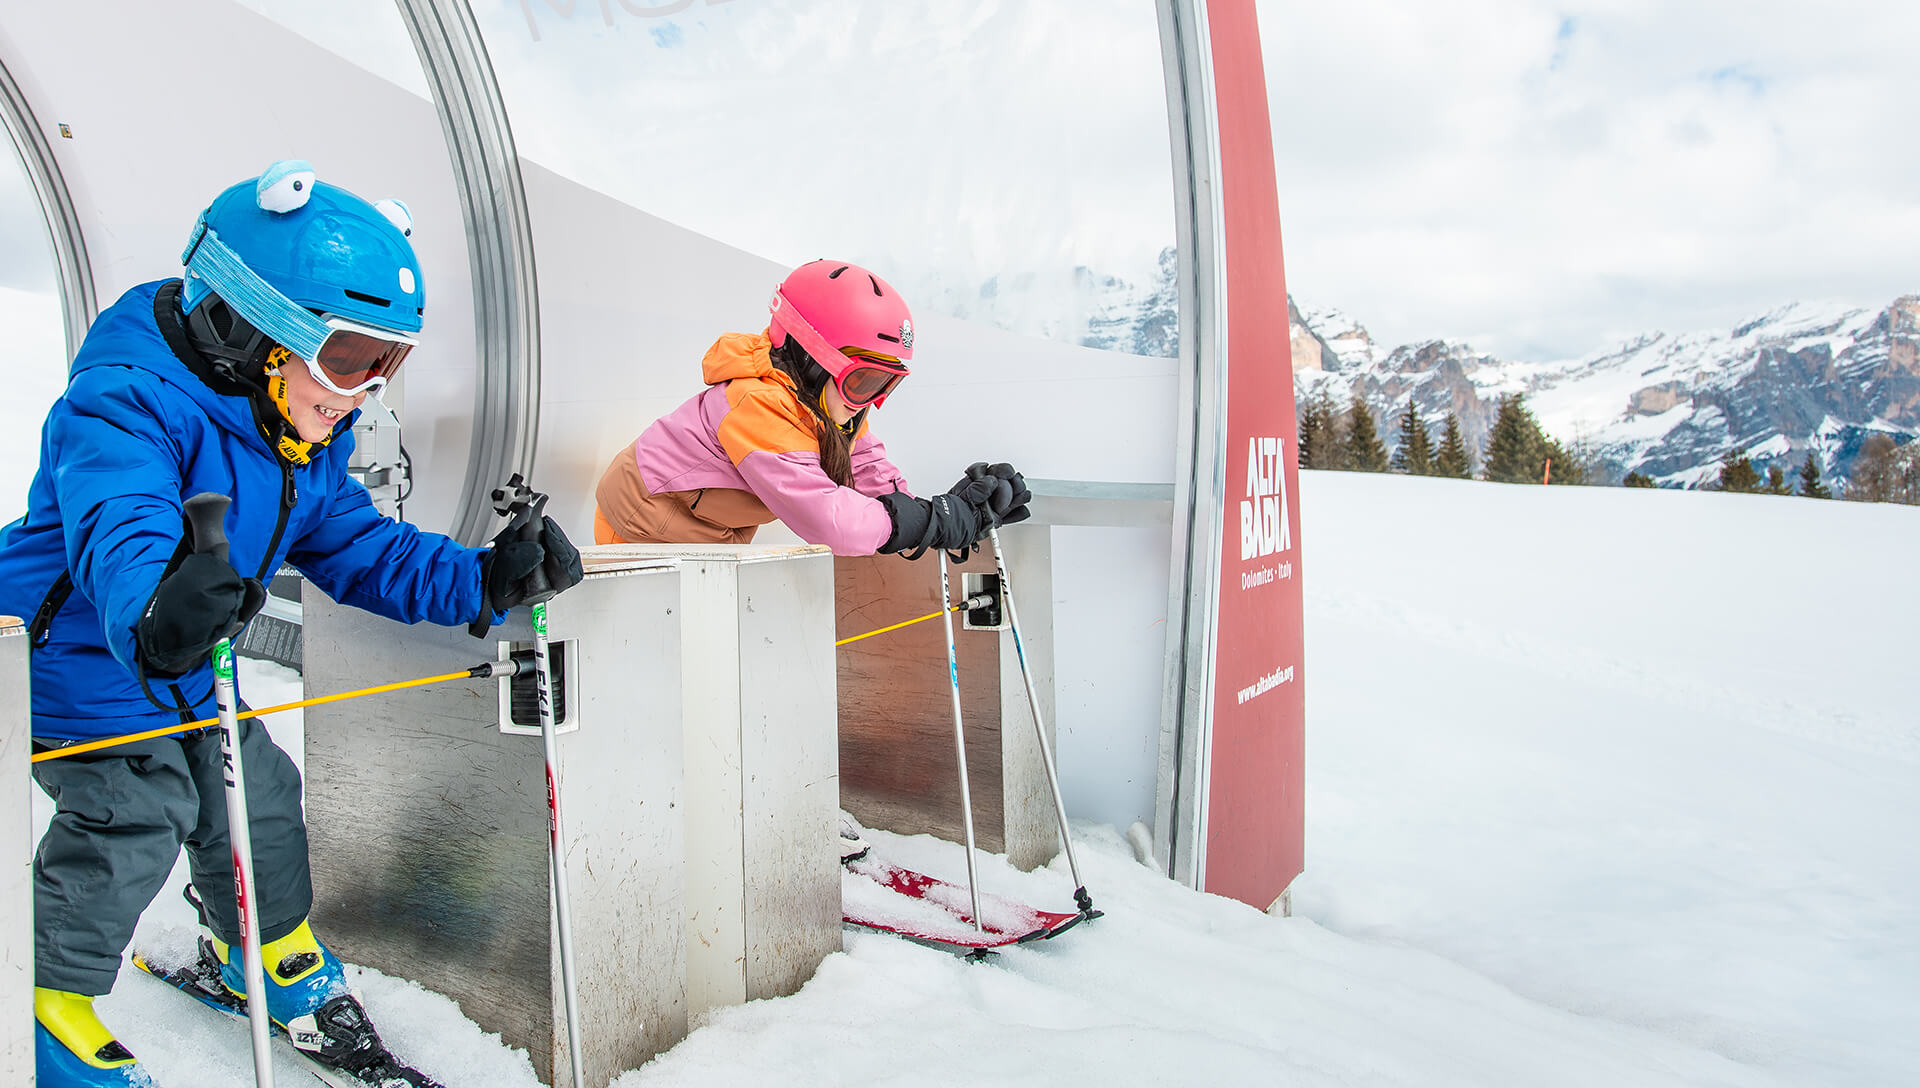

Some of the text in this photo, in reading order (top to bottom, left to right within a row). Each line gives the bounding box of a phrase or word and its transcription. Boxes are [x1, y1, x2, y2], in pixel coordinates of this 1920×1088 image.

[1246, 437, 1286, 498] ALTA
[1240, 496, 1291, 561] BADIA
[1241, 560, 1292, 591] Dolomites Italy
[1238, 665, 1294, 704] www.altabadia.org
